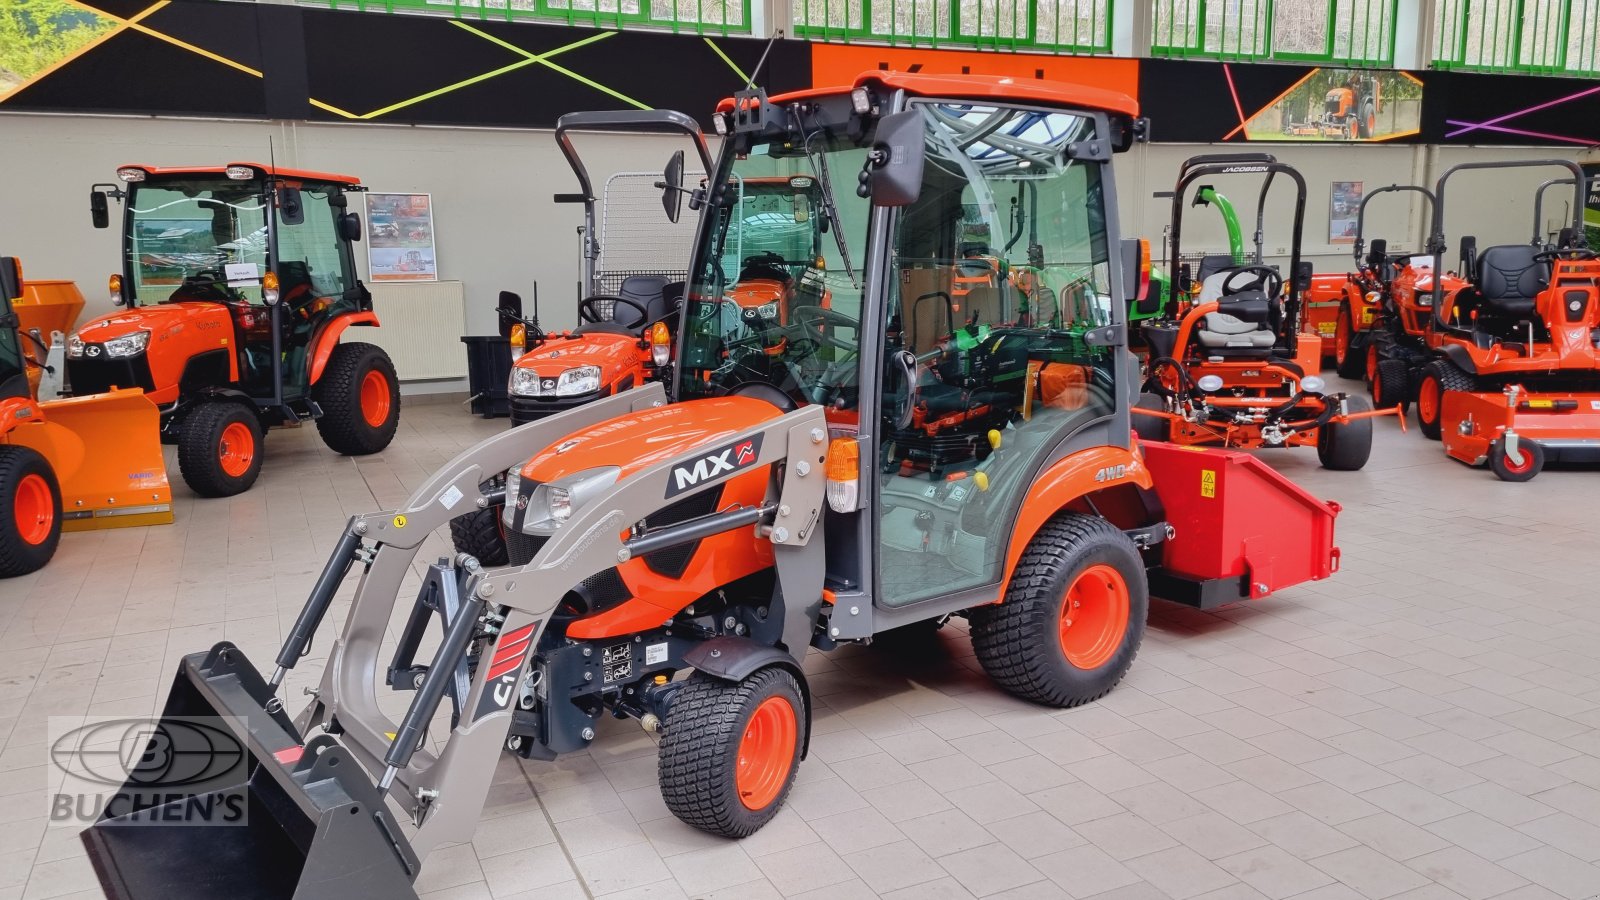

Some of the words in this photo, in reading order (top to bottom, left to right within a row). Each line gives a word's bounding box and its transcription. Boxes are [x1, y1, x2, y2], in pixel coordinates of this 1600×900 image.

[674, 448, 735, 490] MX
[1095, 464, 1126, 483] 4WD
[494, 675, 516, 707] C1
